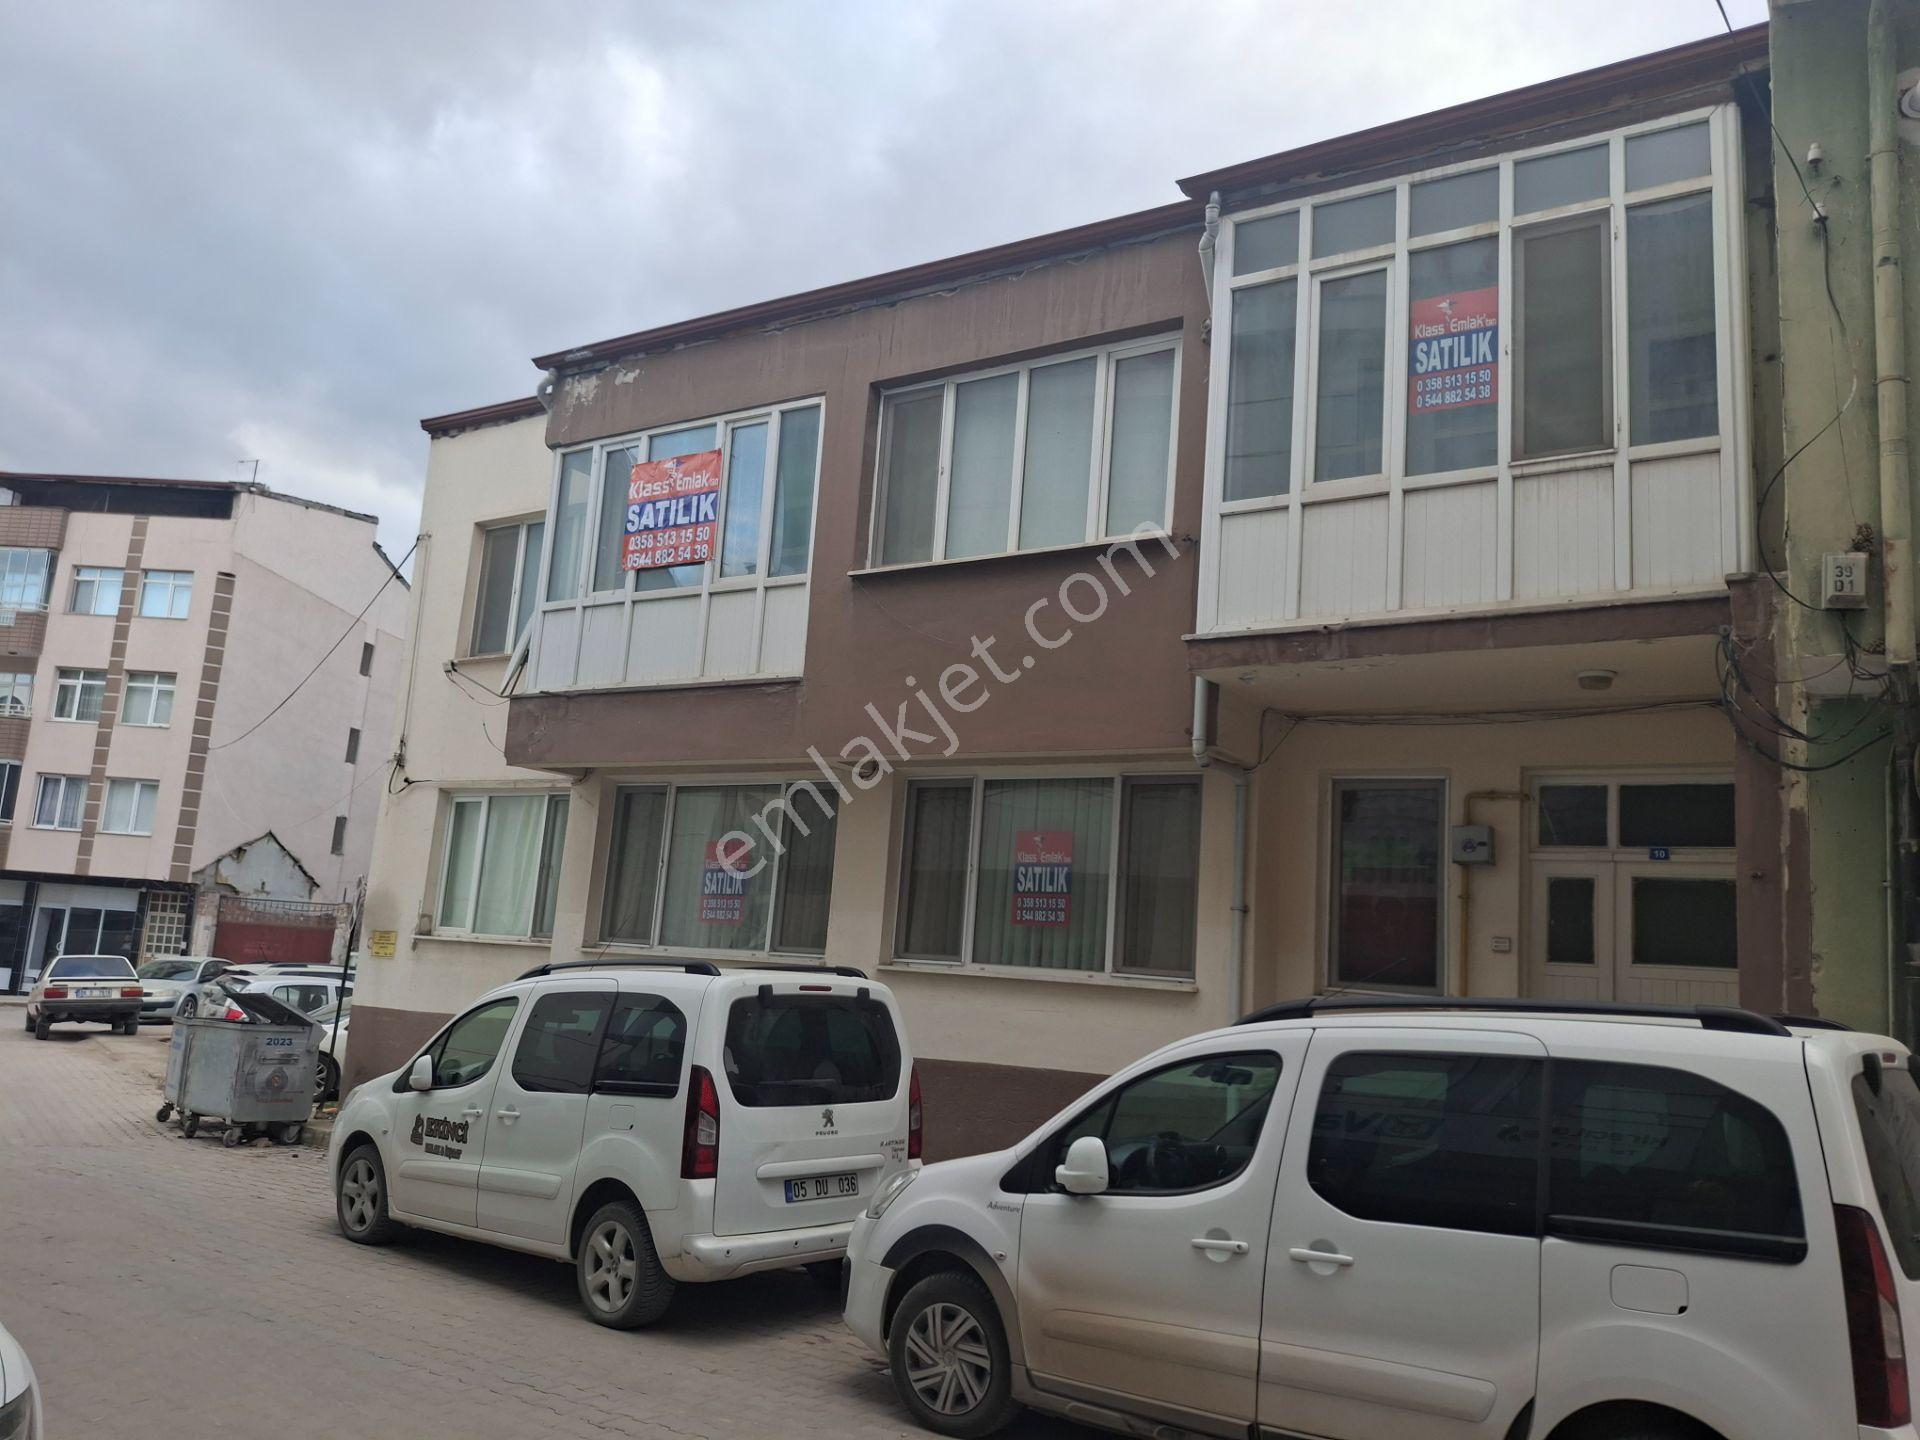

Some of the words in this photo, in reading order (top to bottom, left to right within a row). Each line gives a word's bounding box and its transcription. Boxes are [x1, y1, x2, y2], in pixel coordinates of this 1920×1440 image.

[1415, 324, 1444, 339] Klass
[1416, 330, 1493, 373] SATILIK
[1416, 380, 1423, 392] 0
[1425, 378, 1443, 391] 358
[1445, 375, 1462, 388] 513
[1465, 372, 1476, 385] 15
[1479, 369, 1491, 382] 50
[1416, 395, 1423, 408] 0
[1425, 393, 1442, 407] 544
[1445, 390, 1462, 403] 882
[1465, 387, 1476, 400] 54
[1479, 385, 1491, 398] 38
[629, 480, 669, 499] Klass
[626, 493, 718, 532] SATILIK
[628, 534, 654, 550] 0358
[656, 531, 677, 546] 513
[680, 528, 693, 543] 15
[696, 527, 710, 540] 50
[626, 552, 652, 567] 0544
[655, 548, 675, 563] 882
[678, 546, 691, 561] 54
[694, 544, 708, 559] 38
[1653, 850, 1666, 858] 10
[704, 872, 743, 894] SATILIK
[1017, 866, 1068, 893] SATILIK
[266, 1037, 293, 1046] 2023
[793, 1179, 807, 1198] 05
[815, 1179, 829, 1196] DU
[838, 1176, 857, 1193] 036
[987, 1201, 1021, 1213] Adventure
